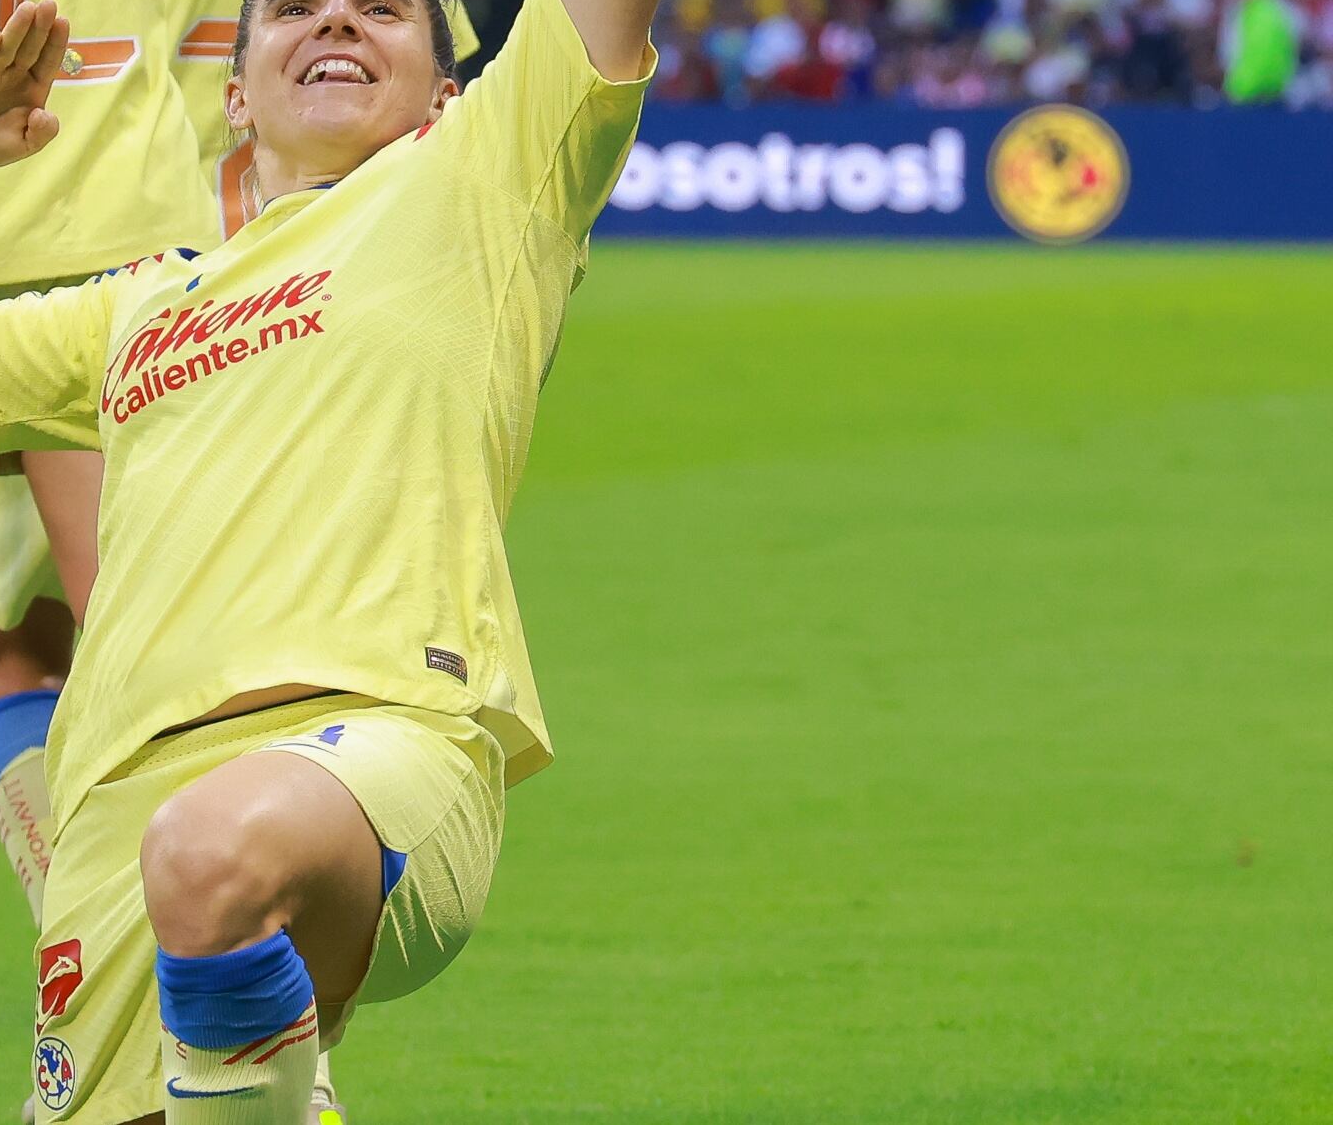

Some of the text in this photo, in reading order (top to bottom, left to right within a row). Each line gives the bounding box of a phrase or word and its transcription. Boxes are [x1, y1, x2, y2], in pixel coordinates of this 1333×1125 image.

[609, 127, 966, 215] osotros!
[101, 269, 332, 415] Caliente
[113, 309, 326, 425] caliente.mx
